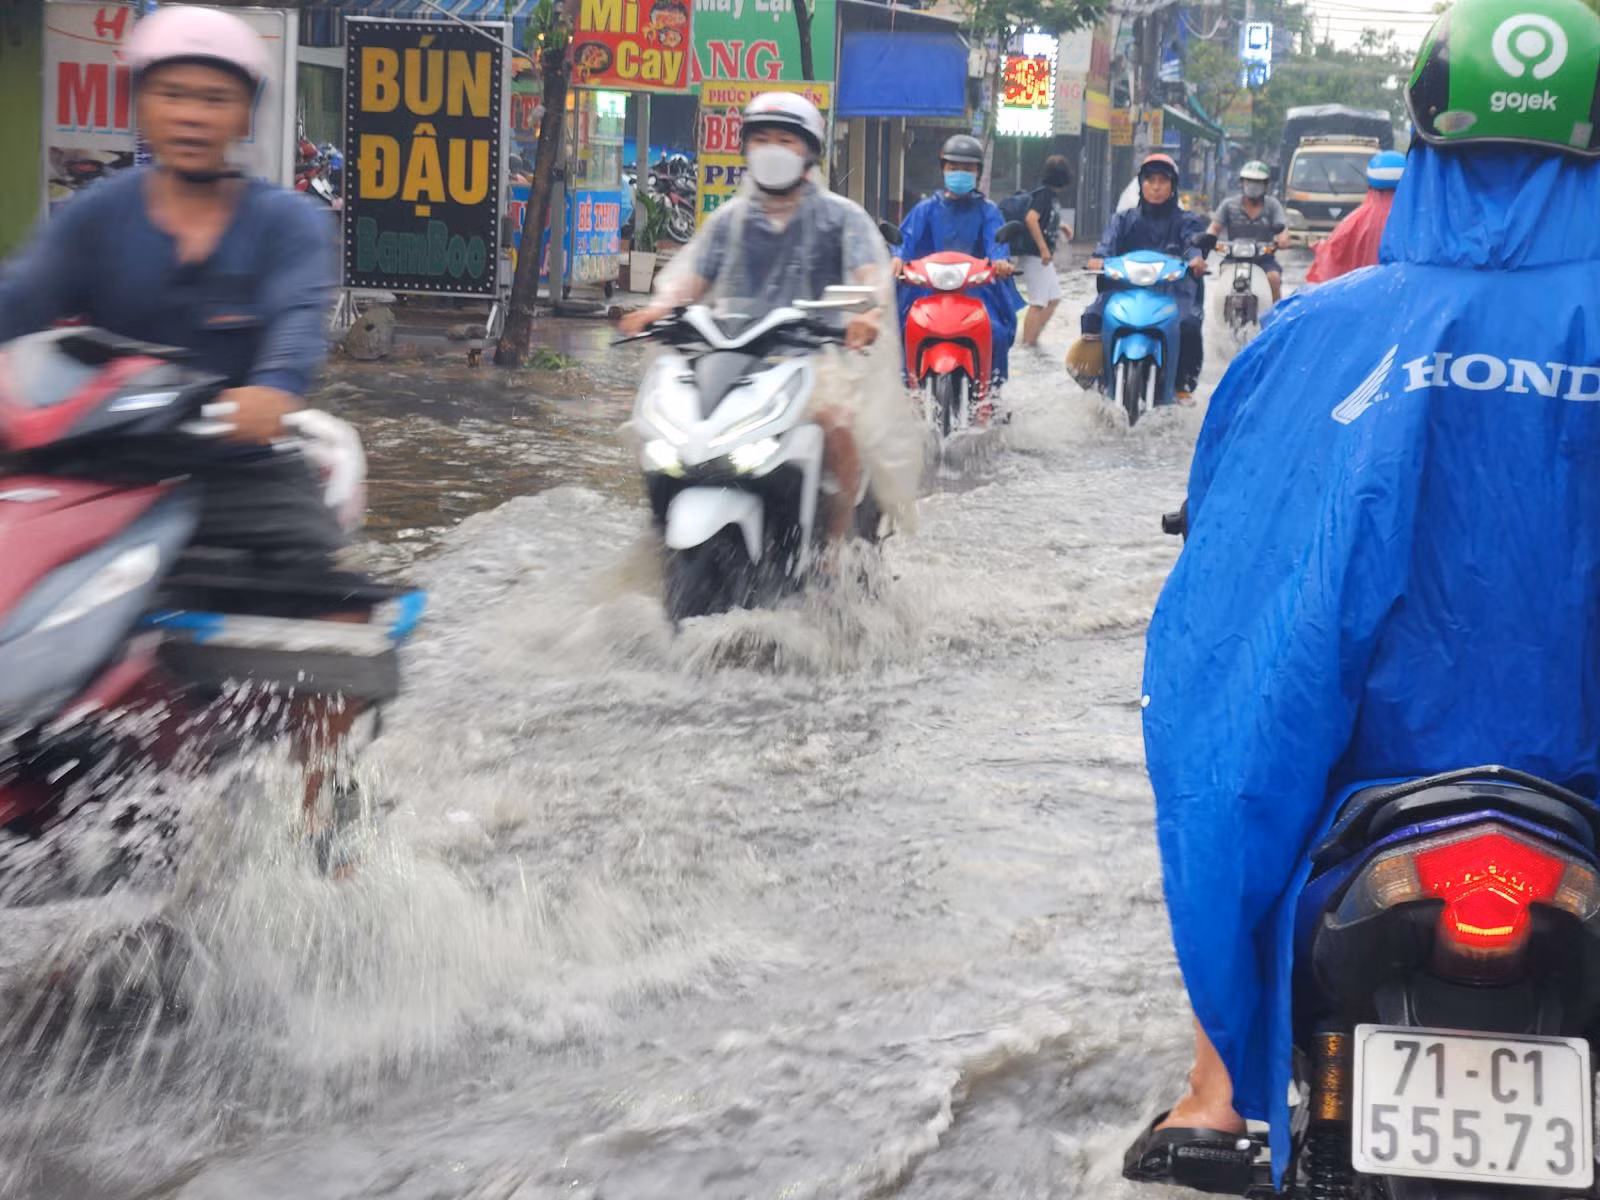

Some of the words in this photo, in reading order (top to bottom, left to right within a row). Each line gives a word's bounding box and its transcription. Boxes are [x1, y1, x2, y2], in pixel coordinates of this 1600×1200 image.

[361, 34, 492, 118] BÚN
[616, 40, 684, 85] Cay
[708, 87, 746, 103] PHÚC
[1490, 89, 1558, 112] gojek
[357, 122, 490, 218] ĐẬU
[356, 216, 487, 279] BamBoo
[1393, 1039, 1544, 1106] 71-C1
[1370, 1103, 1575, 1176] 555.73
